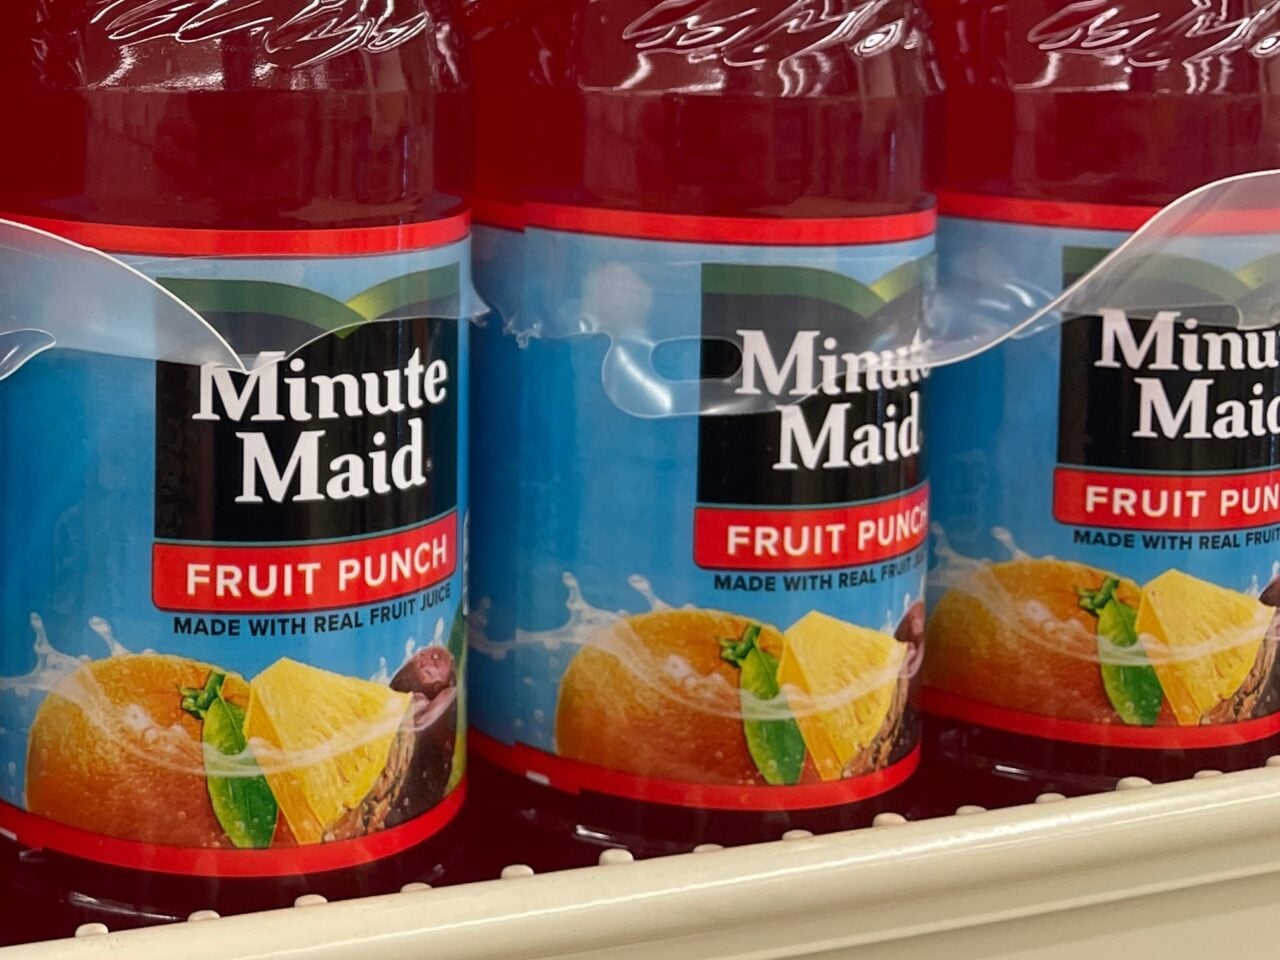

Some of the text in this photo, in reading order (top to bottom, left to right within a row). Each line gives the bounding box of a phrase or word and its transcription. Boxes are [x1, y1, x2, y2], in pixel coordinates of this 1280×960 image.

[1094, 308, 1280, 371] Minu
[192, 347, 447, 421] Minute
[772, 391, 920, 470] Maid
[235, 417, 426, 503] Maid
[1086, 483, 1280, 518] FRUIT PUN
[186, 534, 447, 597] FRUIT PUNCH
[726, 524, 846, 556] FRUIT
[1073, 526, 1280, 550] MADE WITH REAL FRUIT
[714, 560, 911, 592] MADE WITH REAL FRUIT
[173, 582, 451, 636] MADE WITH REAL FRUIT JUICE
